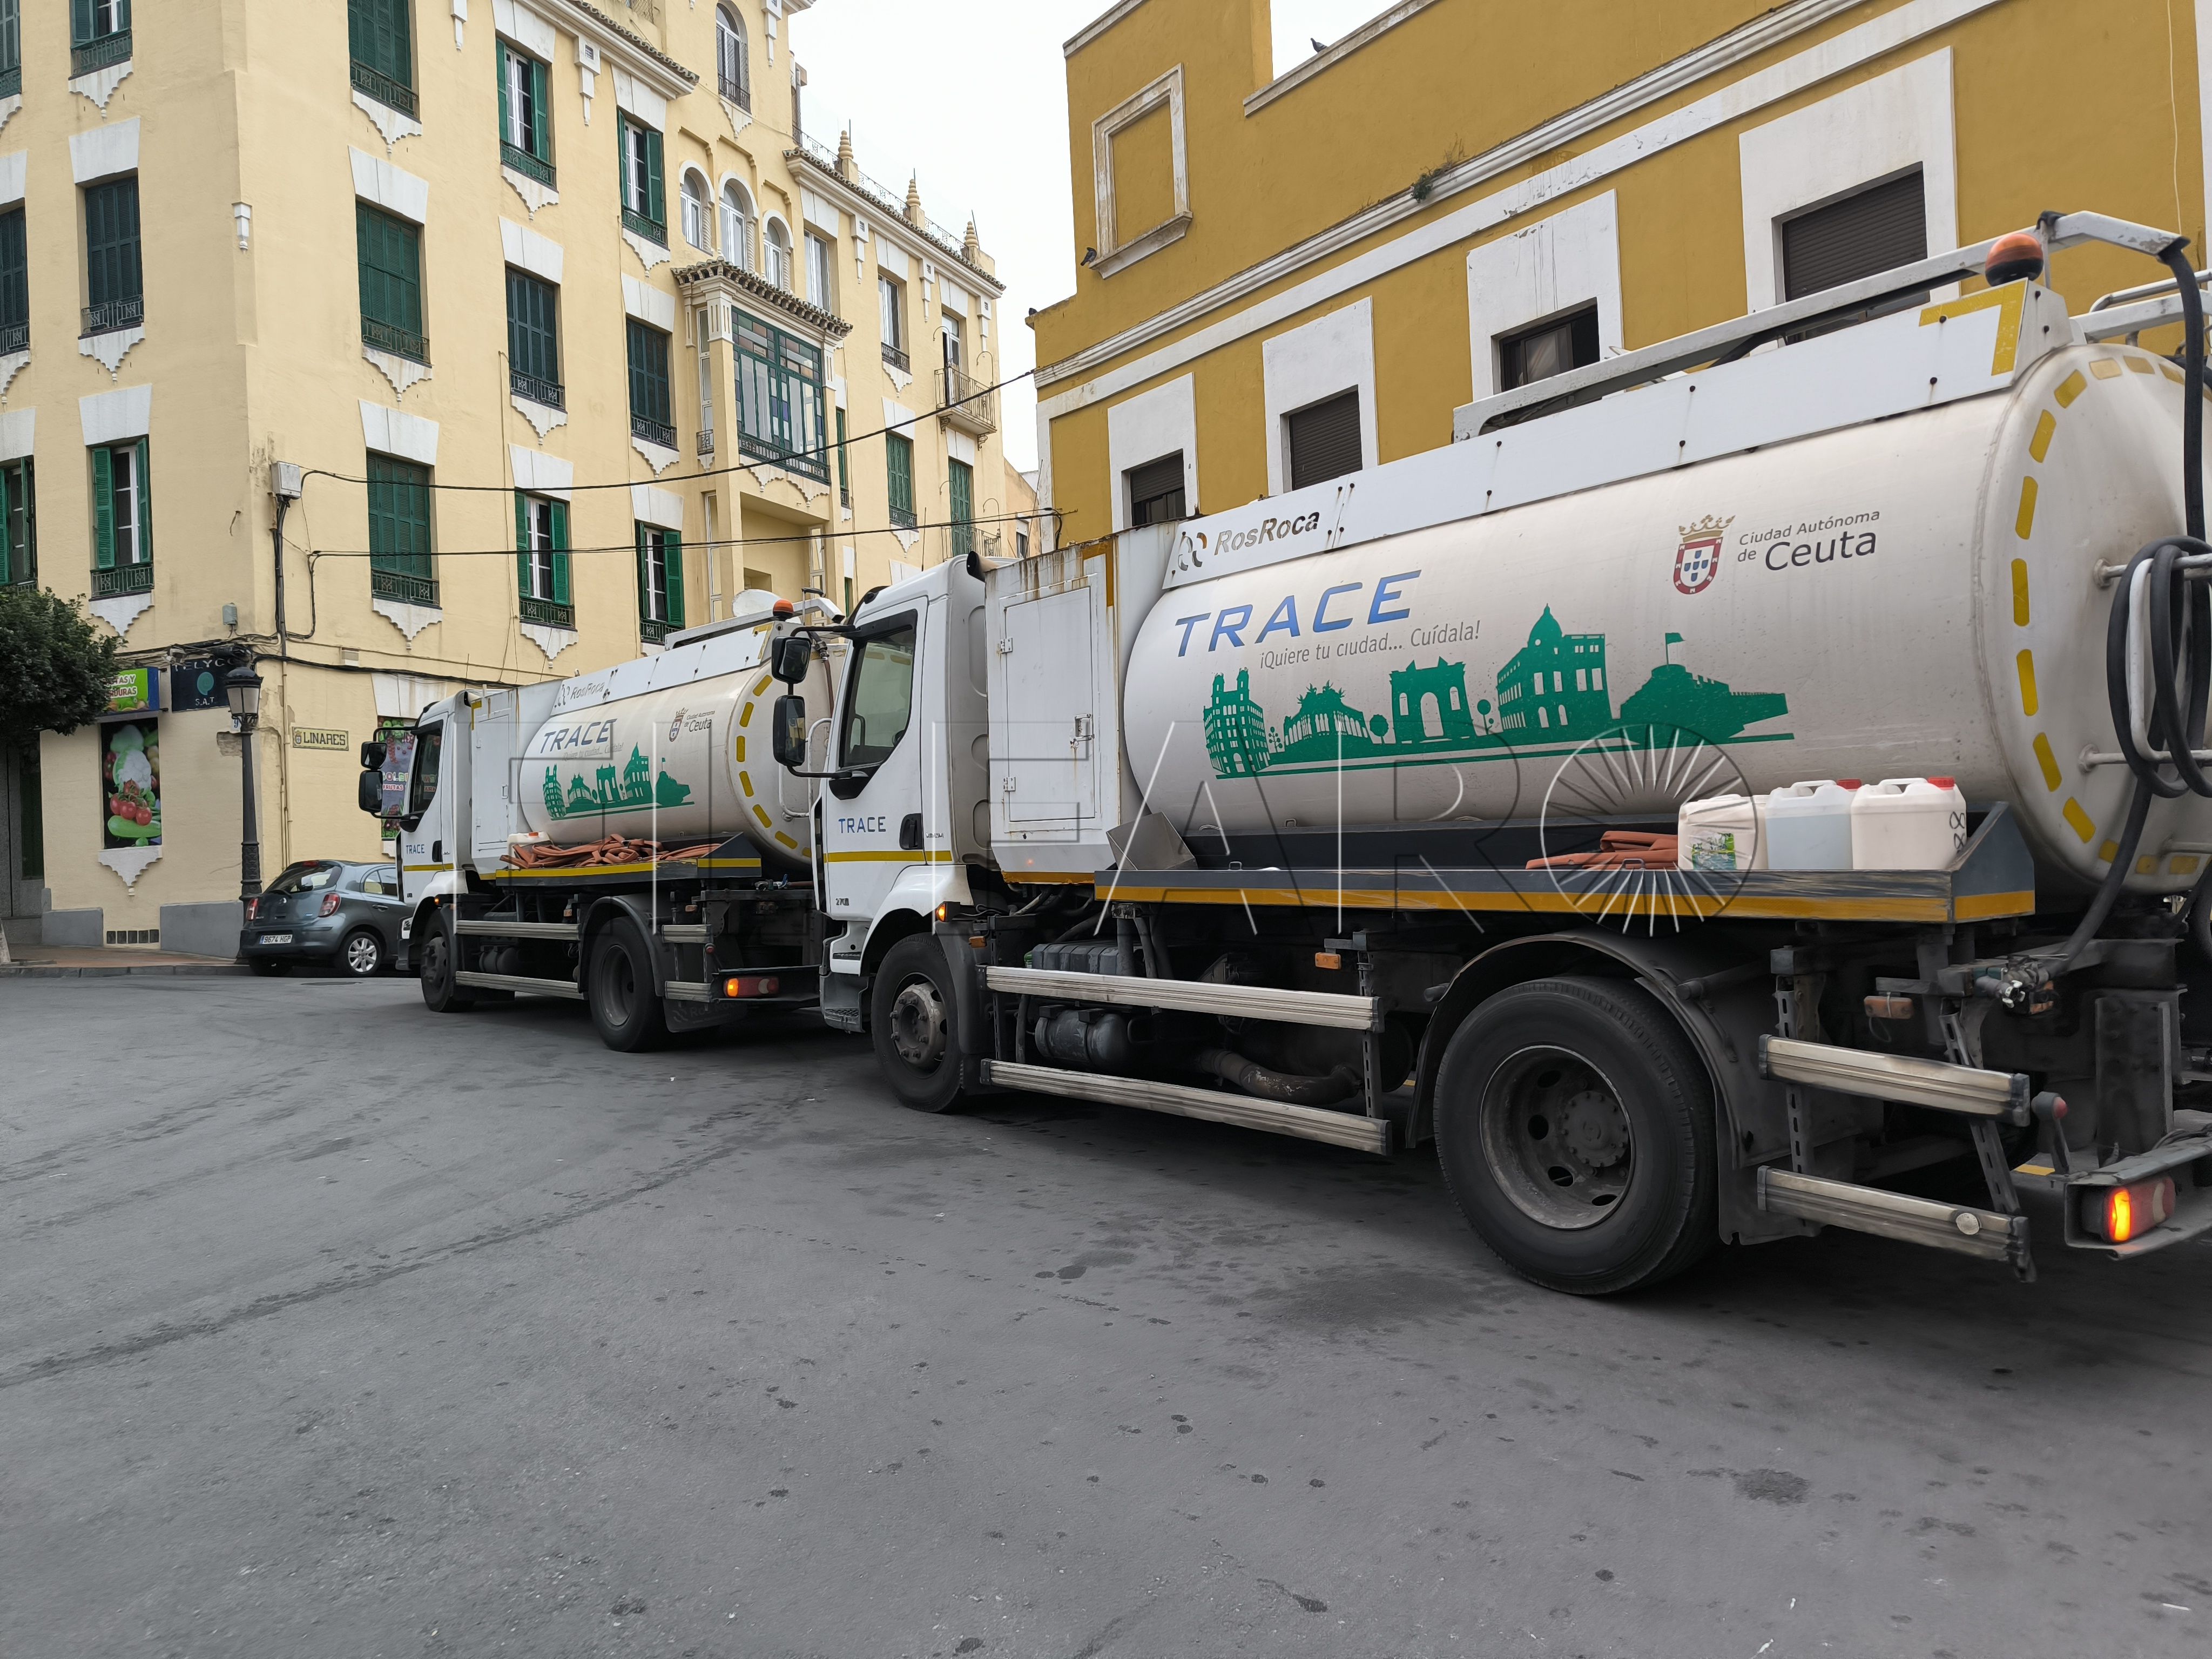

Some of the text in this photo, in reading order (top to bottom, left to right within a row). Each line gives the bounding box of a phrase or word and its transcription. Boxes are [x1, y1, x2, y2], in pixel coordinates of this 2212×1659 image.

[1215, 512, 1319, 555] RosRoca
[1739, 511, 1880, 545] Ciudad Autónoma
[1737, 531, 1876, 571] de Ceuta
[1175, 569, 1422, 657] TRACE
[1260, 648, 1310, 670] ¡Quiere
[1316, 643, 1330, 660] tu
[1411, 620, 1480, 647] Cuídala!
[303, 732, 346, 746] LINARES
[540, 718, 618, 754] TRACE
[689, 718, 712, 732] Ceuta
[838, 816, 886, 834] TRACE
[406, 844, 425, 854] TRACE
